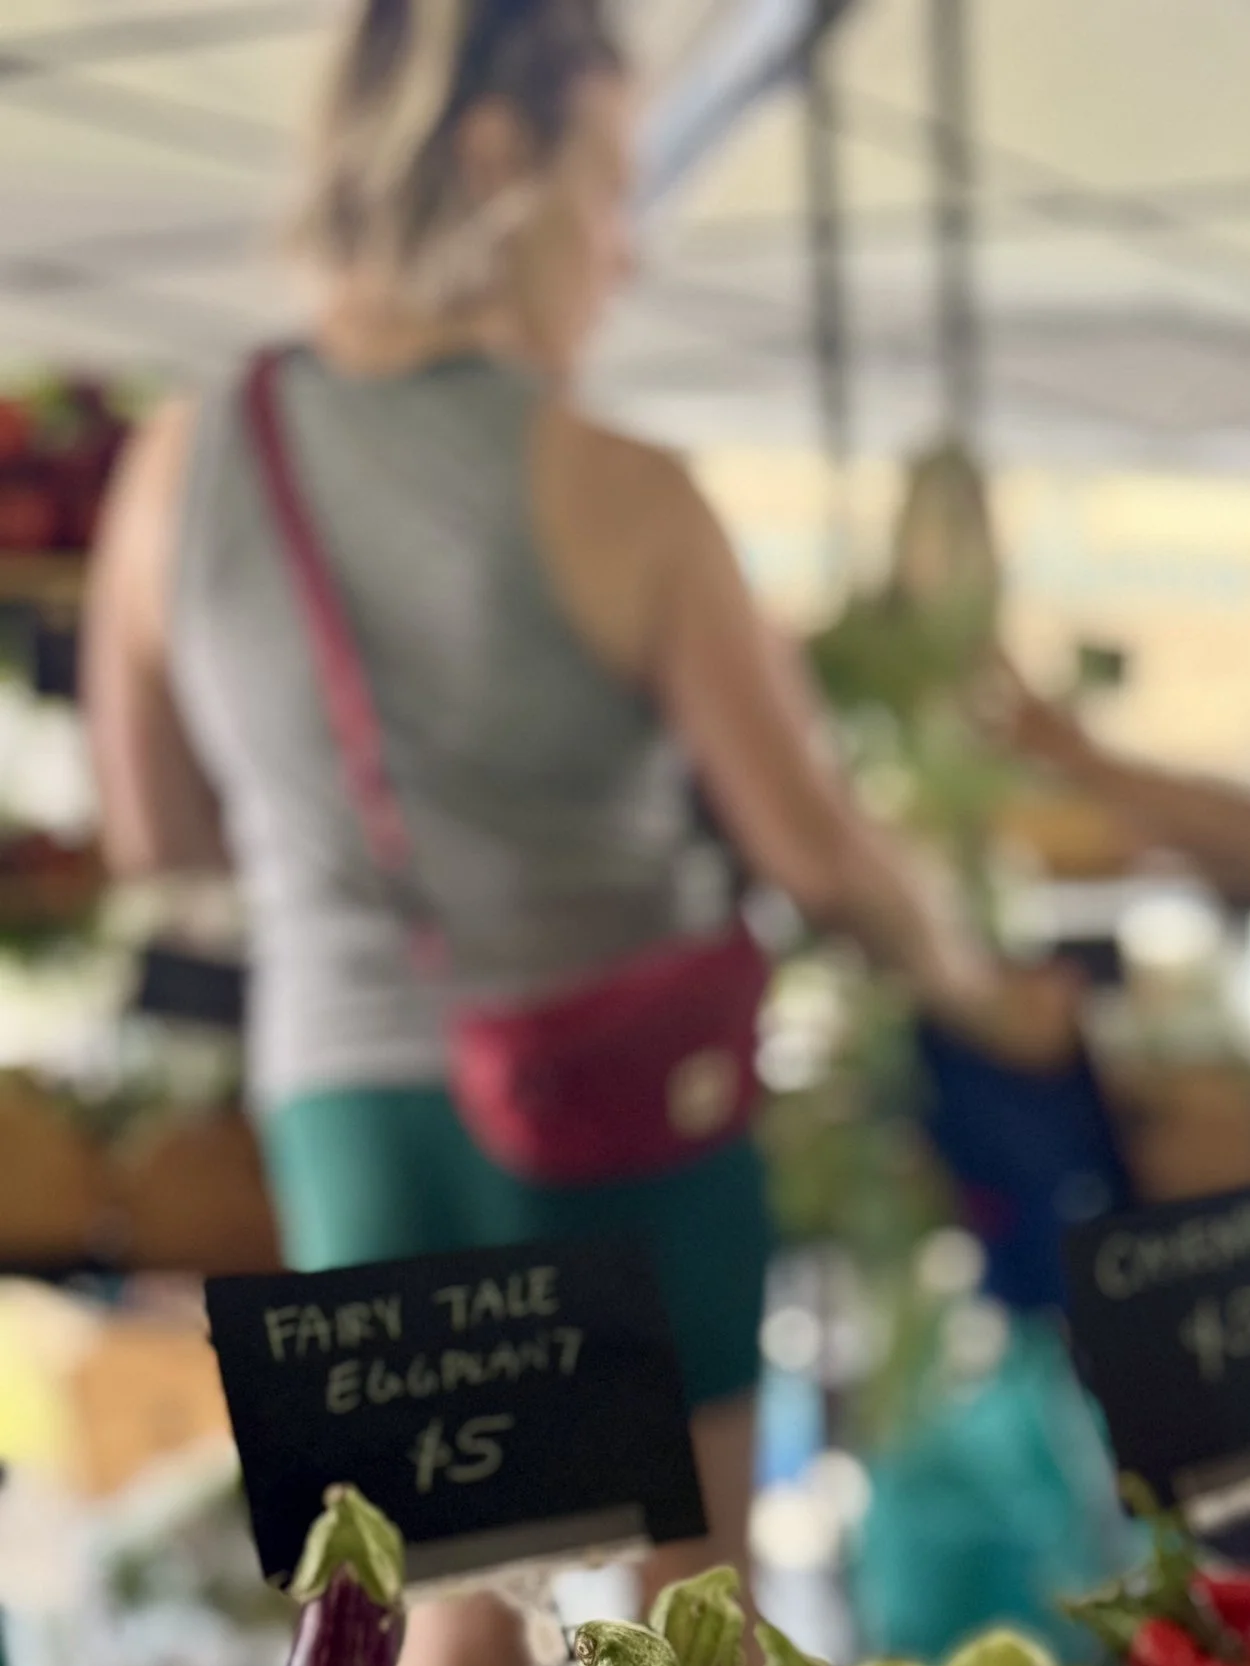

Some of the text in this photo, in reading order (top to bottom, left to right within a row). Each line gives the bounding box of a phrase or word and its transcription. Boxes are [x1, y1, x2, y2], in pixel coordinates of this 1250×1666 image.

[433, 1266, 559, 1332] TALE
[325, 1326, 585, 1415] EGGPLANT
[408, 1412, 515, 1494] $5
